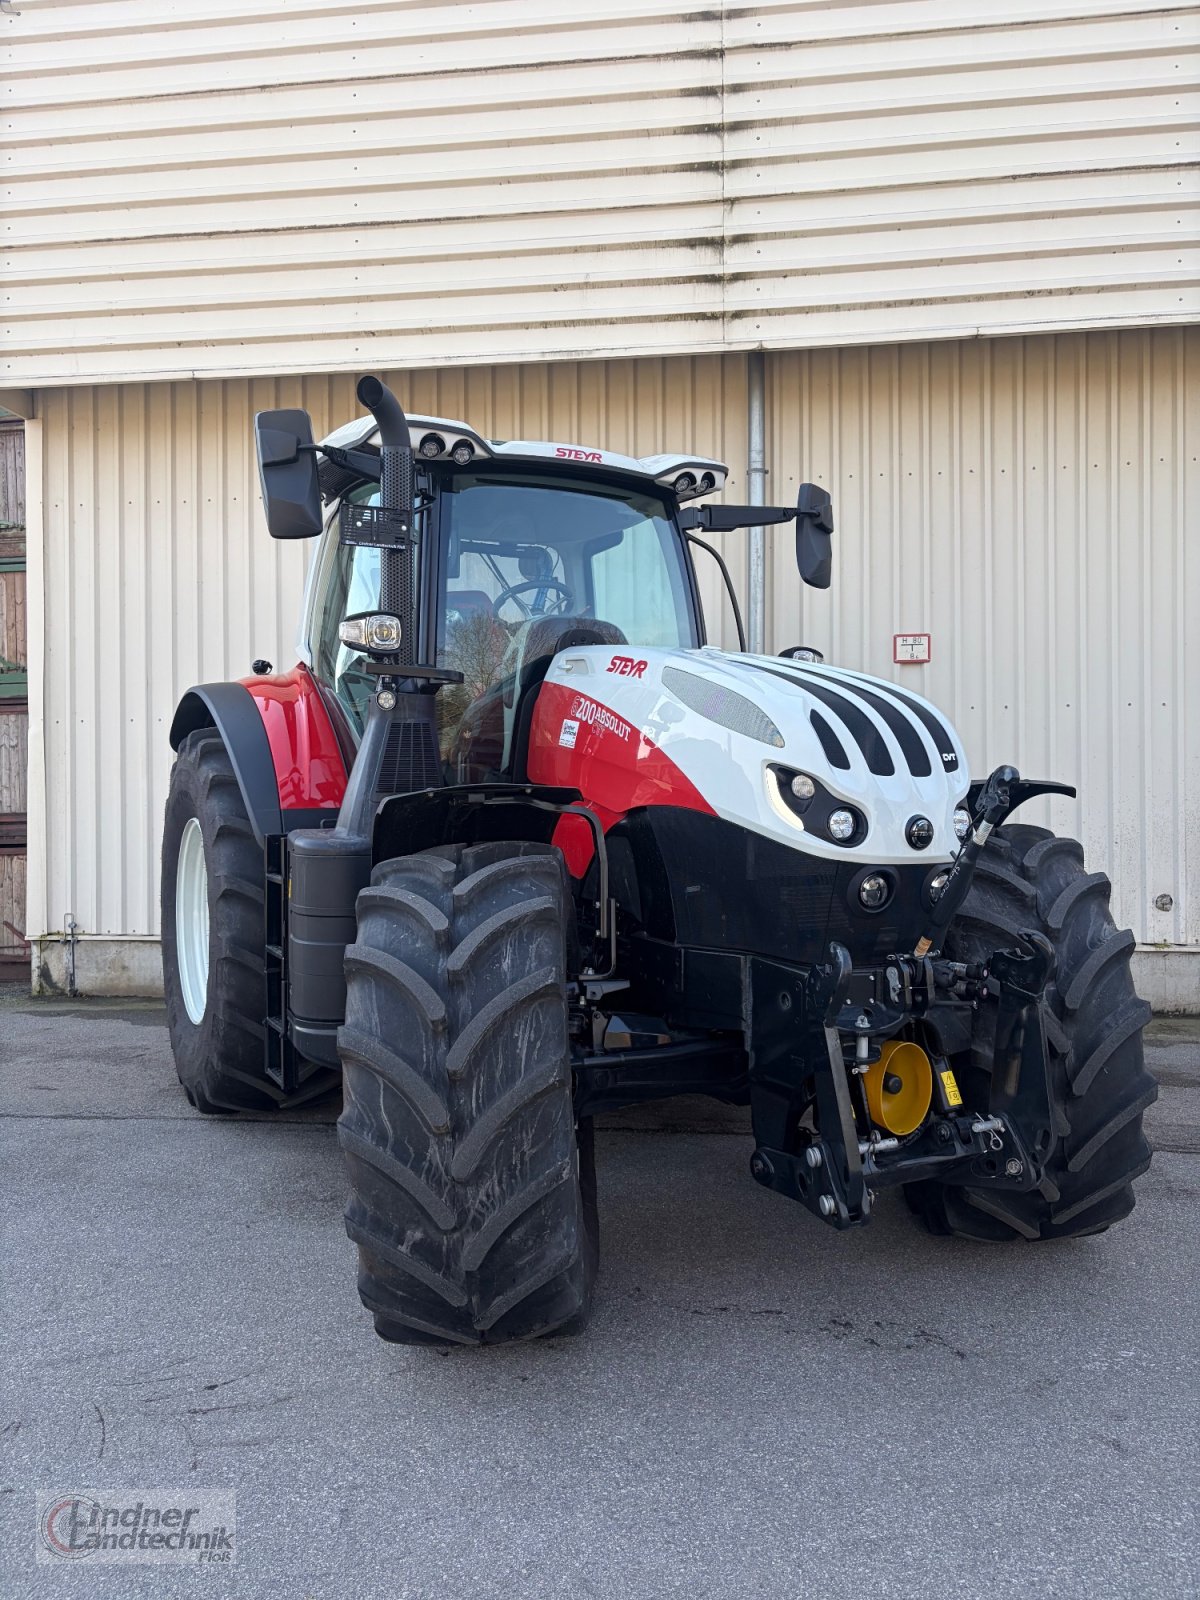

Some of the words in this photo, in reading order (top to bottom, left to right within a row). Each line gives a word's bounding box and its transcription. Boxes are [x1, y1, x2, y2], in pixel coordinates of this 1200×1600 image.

[555, 447, 602, 463] STEYR
[606, 655, 648, 679] STEYR
[595, 706, 631, 742] ABSOLUT
[942, 753, 956, 761] CVT
